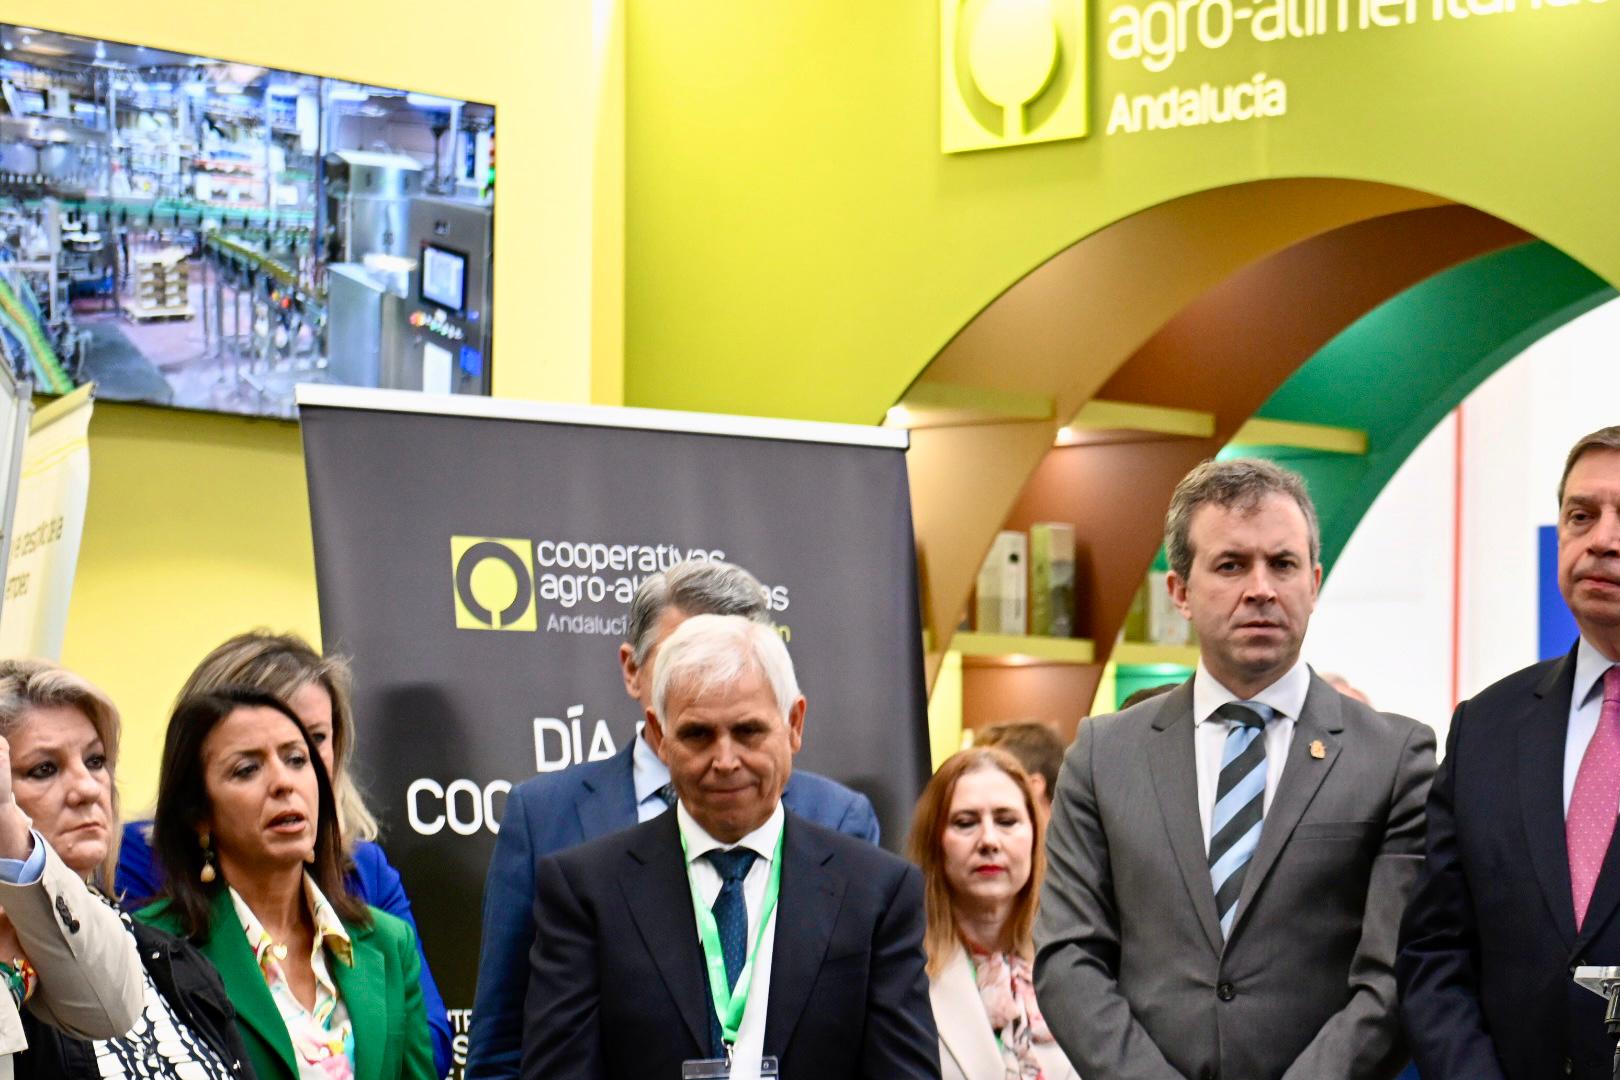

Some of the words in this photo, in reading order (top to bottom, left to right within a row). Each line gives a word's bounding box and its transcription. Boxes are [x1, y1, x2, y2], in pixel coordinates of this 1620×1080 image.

[1106, 0, 1613, 72] agro-alimen
[1106, 72, 1287, 136] Andalucía
[546, 612, 631, 635] Andalucí
[534, 704, 617, 773] DÍA
